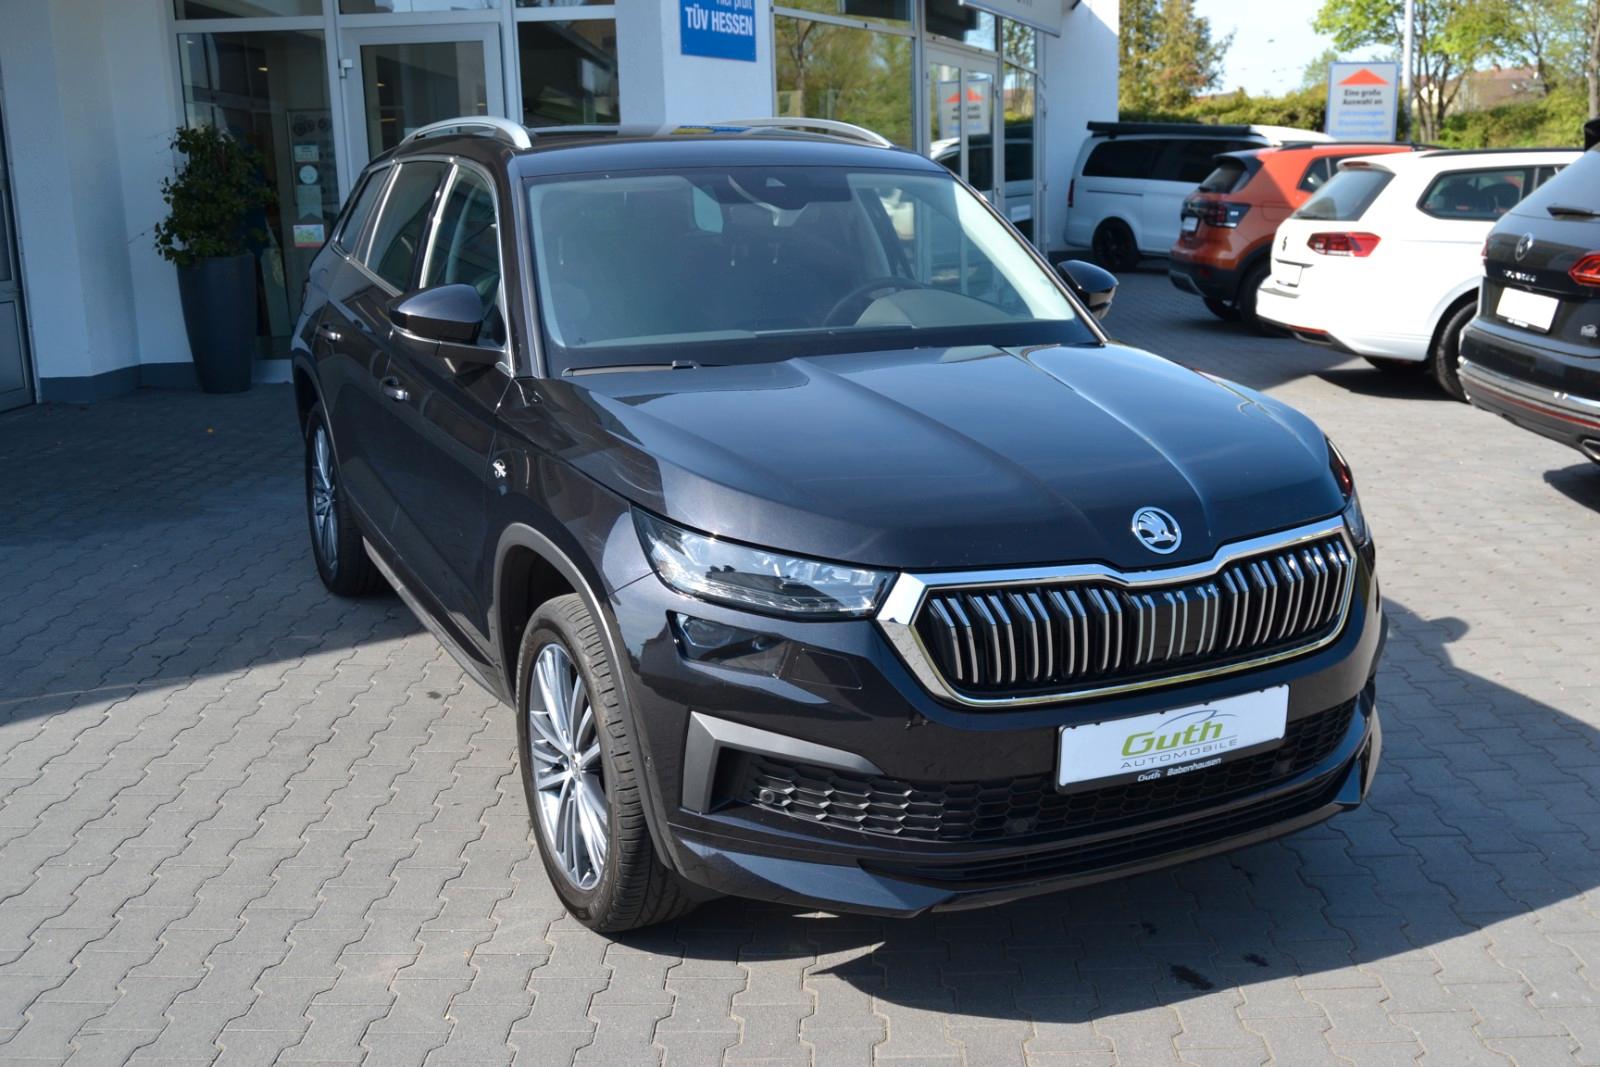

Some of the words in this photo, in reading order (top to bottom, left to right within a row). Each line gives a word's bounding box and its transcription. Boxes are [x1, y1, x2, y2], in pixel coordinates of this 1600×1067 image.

[685, 3, 709, 31] TÜV
[711, 10, 753, 36] HESSEN
[1344, 89, 1360, 97] Eine
[1361, 88, 1382, 98] große
[1120, 738, 1239, 769] AUTOMOBILE
[1121, 720, 1224, 757] Guth
[1137, 769, 1161, 783] Guth
[1166, 757, 1222, 777] Babenhausen
